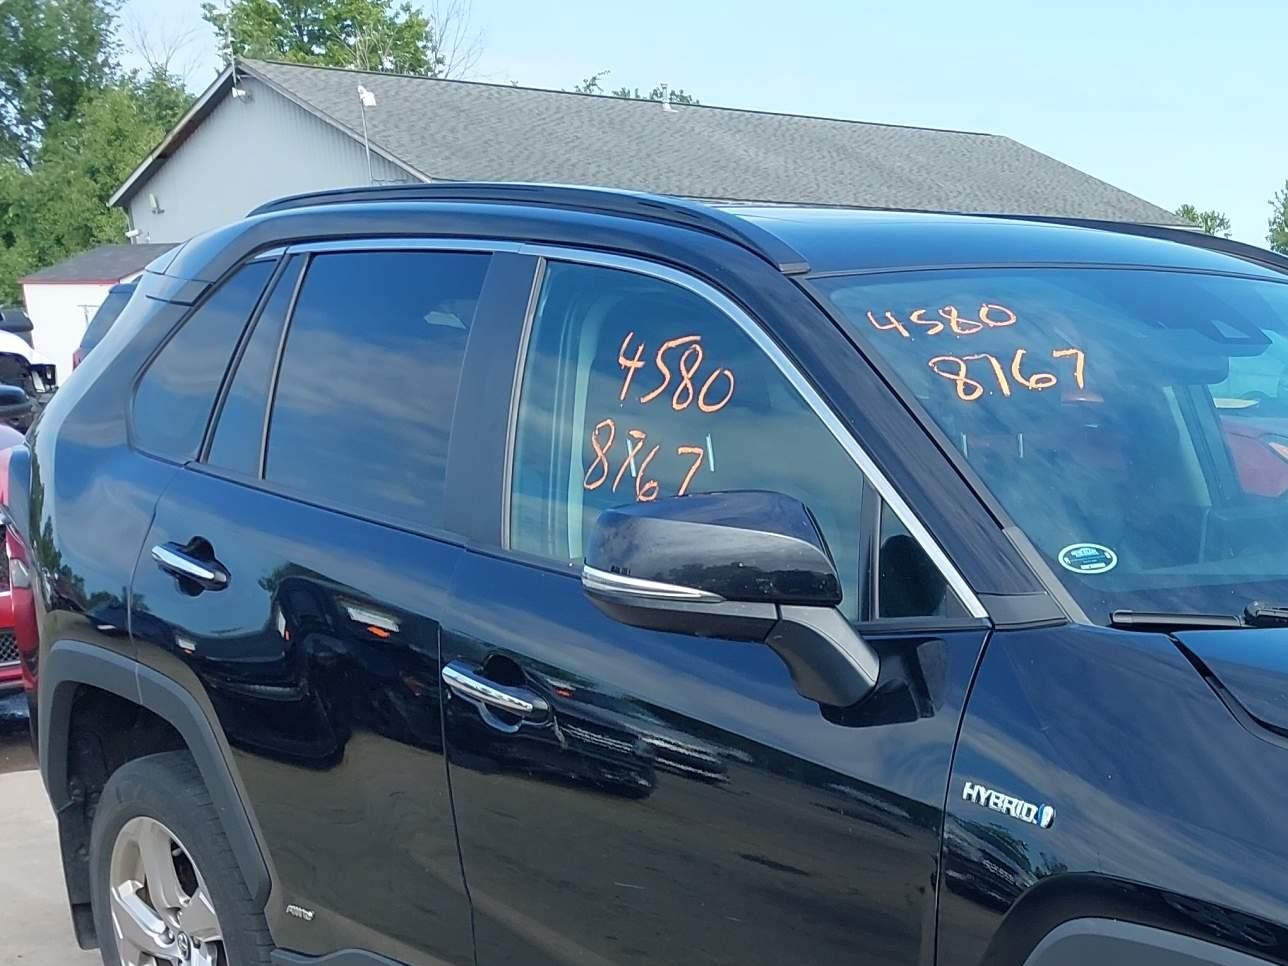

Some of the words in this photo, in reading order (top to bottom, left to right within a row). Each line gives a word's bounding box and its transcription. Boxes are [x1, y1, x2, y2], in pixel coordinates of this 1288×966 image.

[866, 303, 1017, 338] 4580
[617, 331, 736, 413] 4580
[928, 348, 1086, 402] 8767
[583, 417, 705, 502] 8767
[962, 781, 1039, 824] HYBRID
